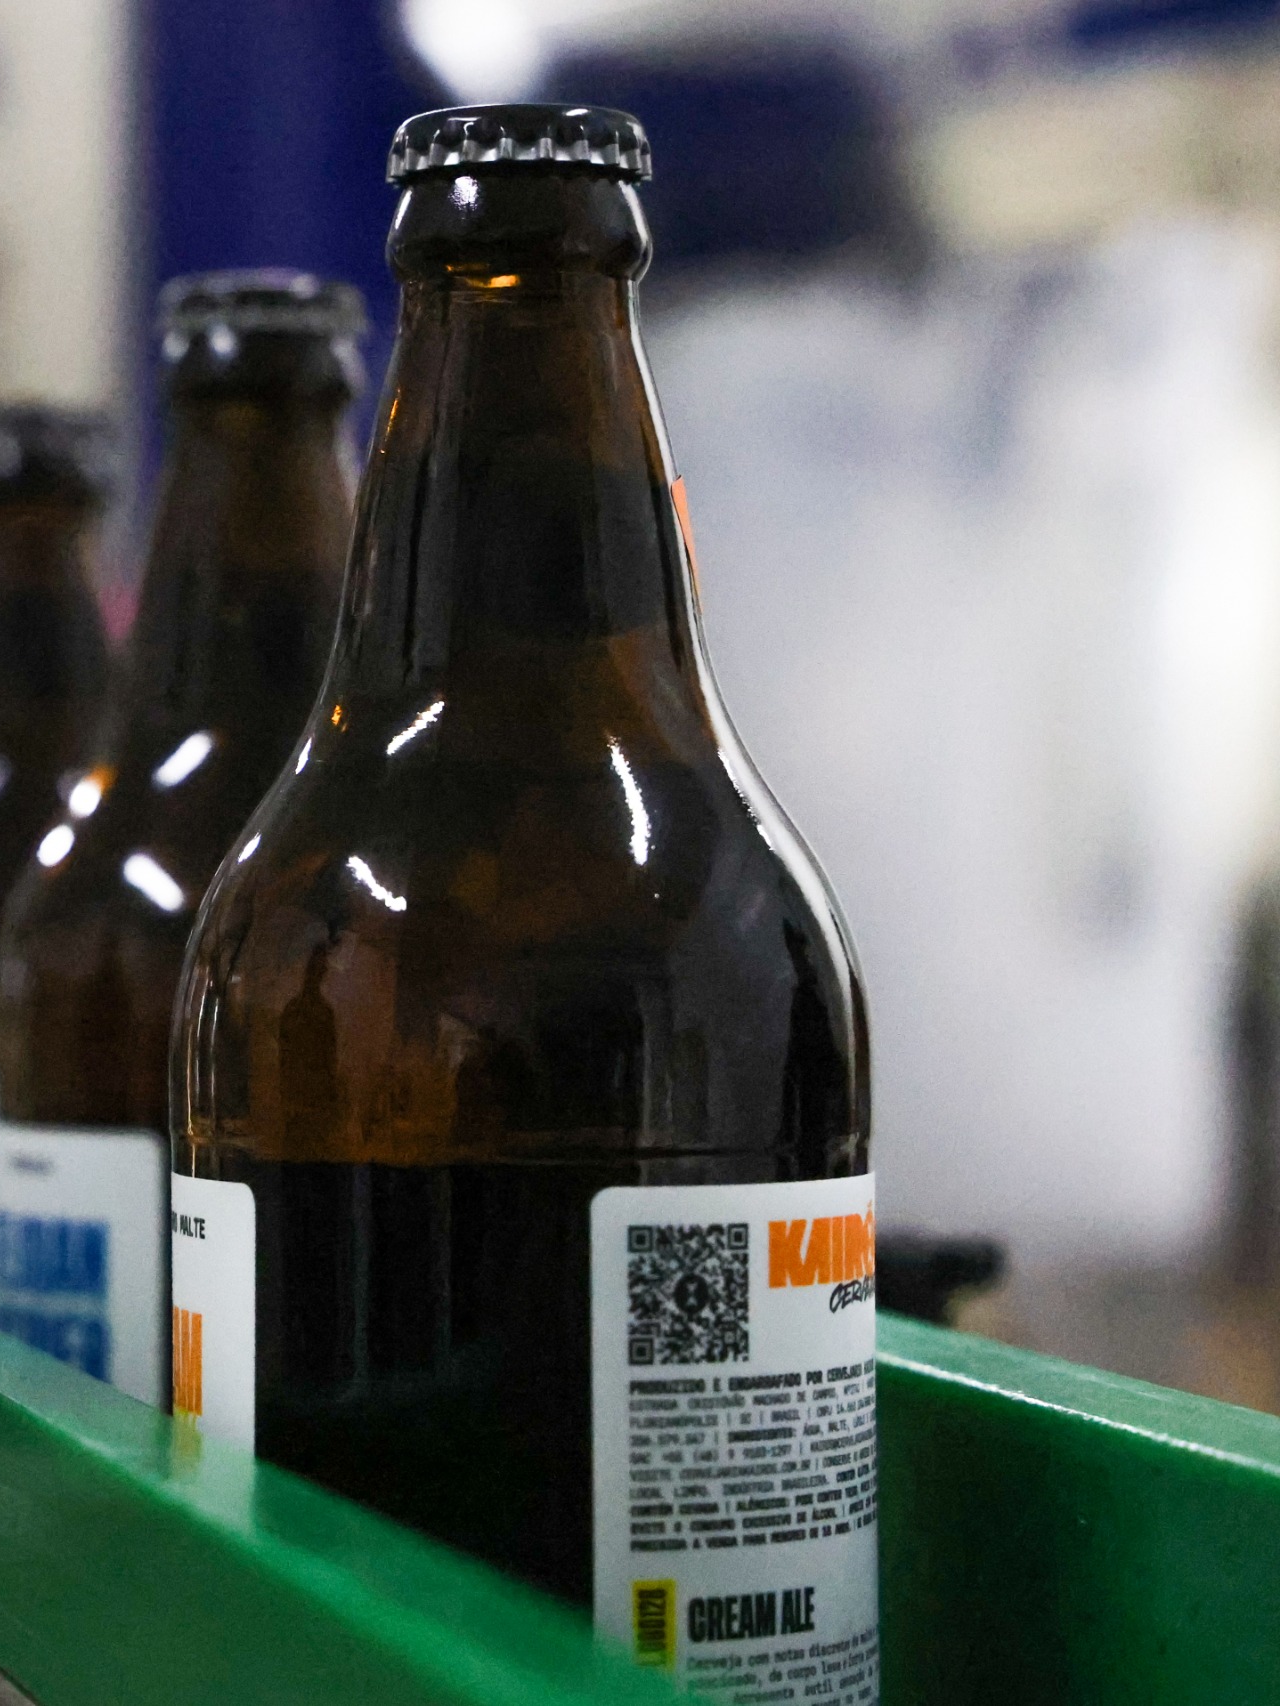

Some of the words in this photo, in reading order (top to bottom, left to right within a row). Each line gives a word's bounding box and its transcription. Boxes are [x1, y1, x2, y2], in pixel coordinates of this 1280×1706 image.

[180, 1217, 206, 1240] MALTE
[713, 1377, 721, 1392] E
[728, 1372, 802, 1392] ENGARRAFADO
[806, 1370, 823, 1386] POR
[797, 1390, 806, 1403] DE
[687, 1590, 776, 1644] CREAM
[780, 1586, 816, 1636] ALE
[686, 1654, 742, 1672] Cerveja
[748, 1652, 770, 1668] com
[774, 1648, 805, 1664] notas
[787, 1665, 817, 1681] corpo
